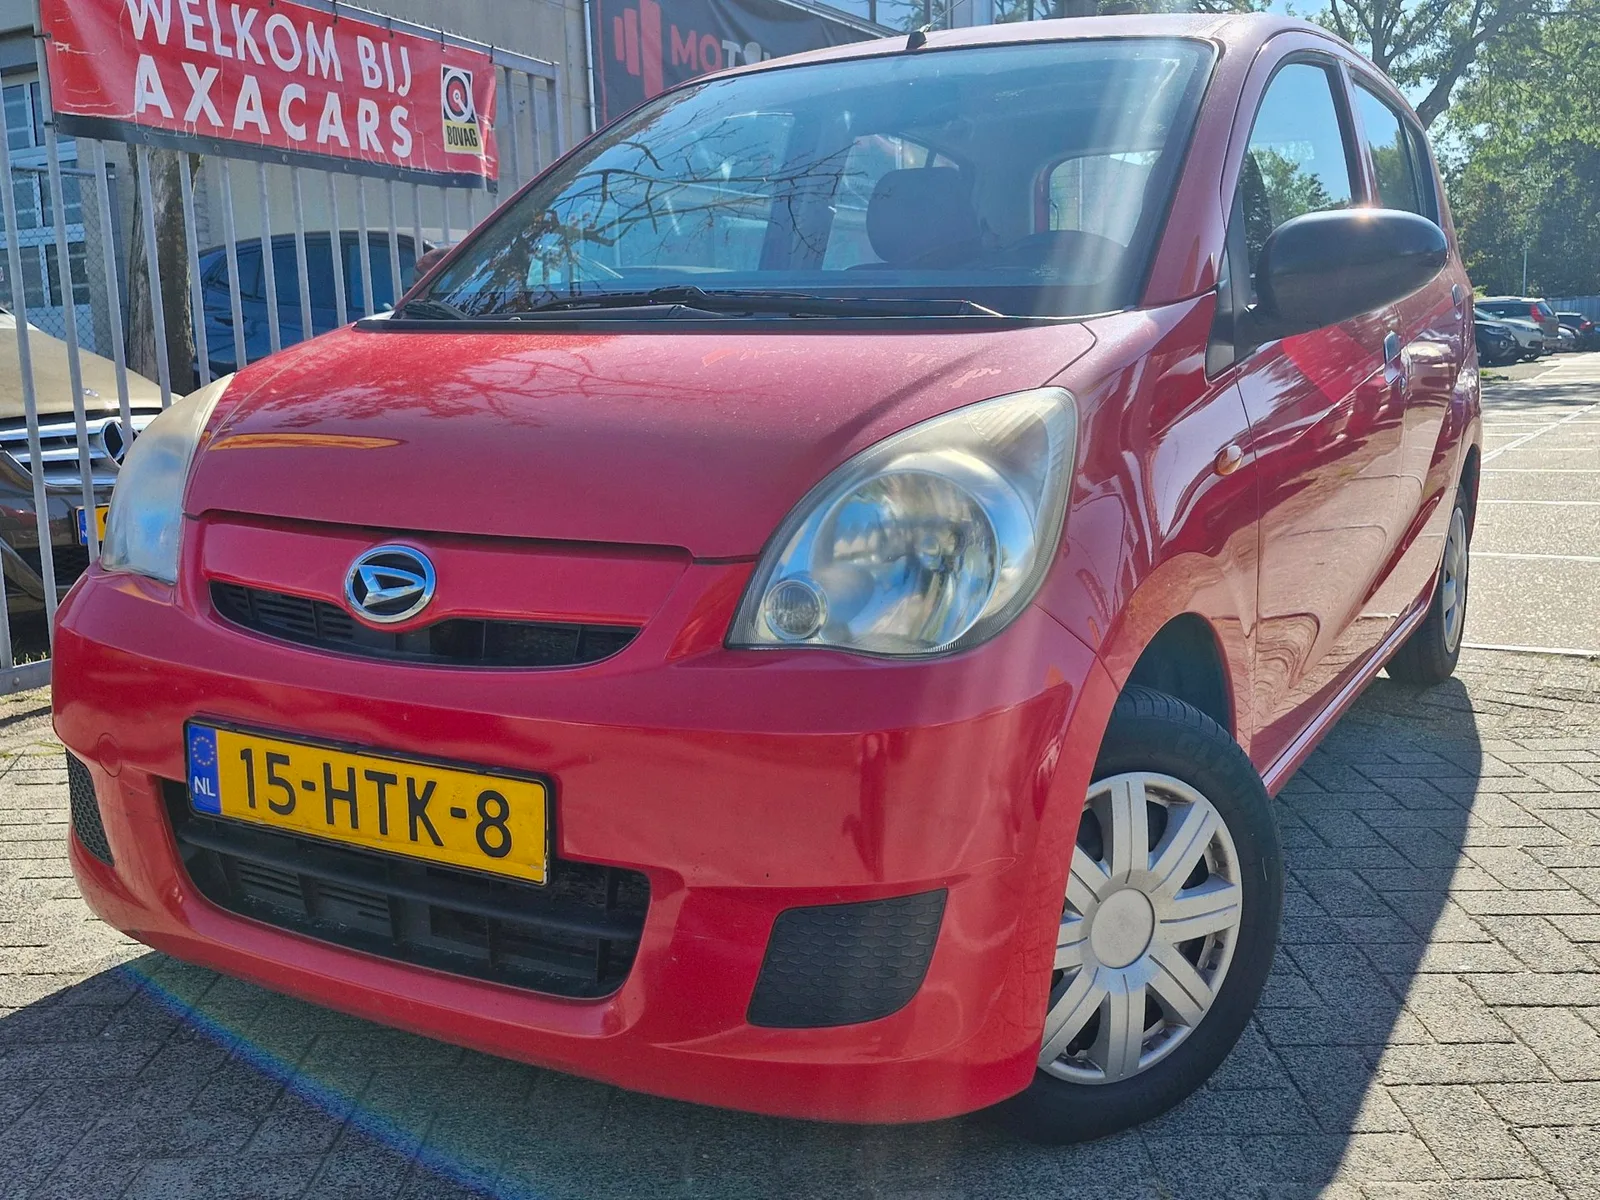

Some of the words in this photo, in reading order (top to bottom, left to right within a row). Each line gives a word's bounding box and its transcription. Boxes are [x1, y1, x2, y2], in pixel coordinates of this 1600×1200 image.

[125, 0, 344, 82] WELKOM
[357, 35, 411, 97] BIJ
[134, 54, 413, 158] AXACARS
[446, 125, 478, 147] BOVAG
[193, 775, 216, 798] NL
[240, 748, 513, 859] 15-HTK-8
